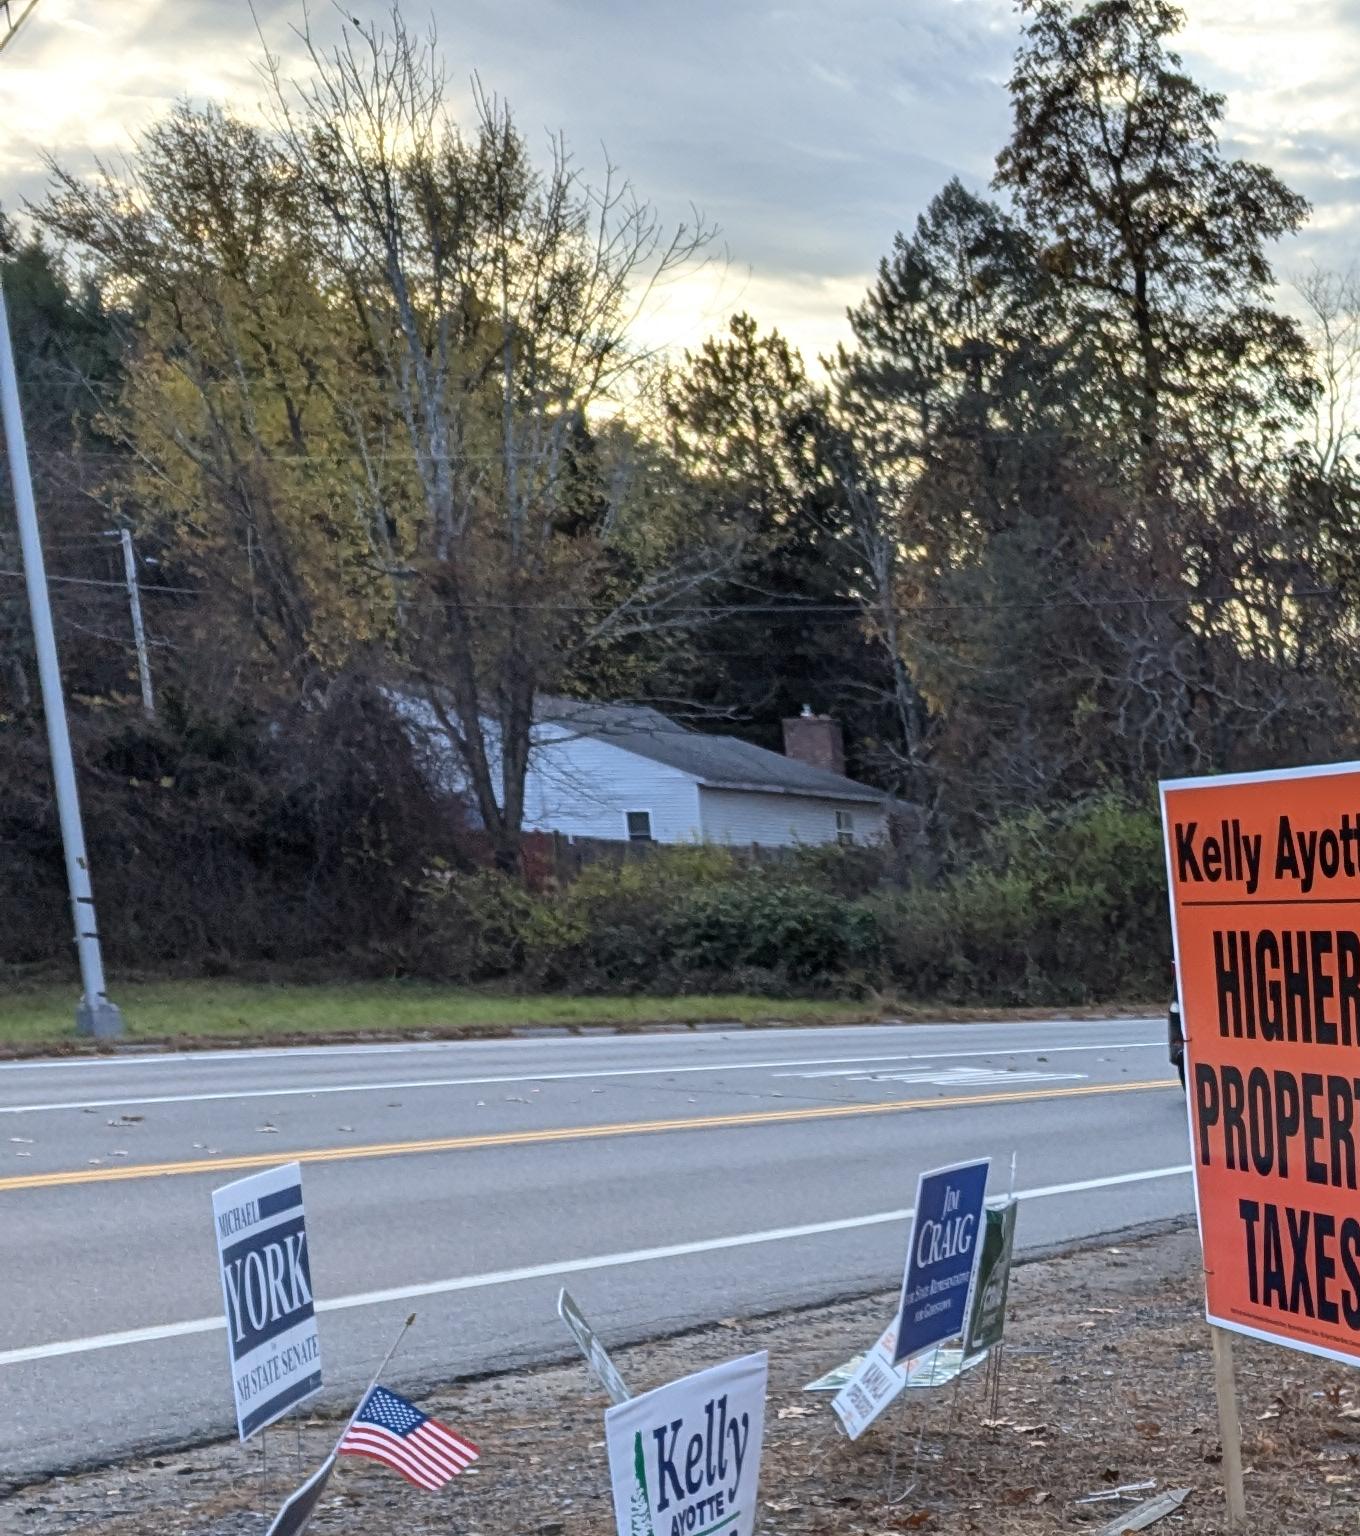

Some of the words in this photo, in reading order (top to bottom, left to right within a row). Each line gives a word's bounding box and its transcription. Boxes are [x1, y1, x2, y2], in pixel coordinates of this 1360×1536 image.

[1175, 819, 1262, 894] Kelly
[218, 1199, 259, 1237] MICHAEL
[917, 1213, 974, 1269] CRAIG
[224, 1231, 313, 1342] YORK
[237, 1374, 251, 1404] NH
[250, 1353, 280, 1395] STATE
[280, 1334, 319, 1377] SENATE
[653, 1394, 749, 1512] Kelly
